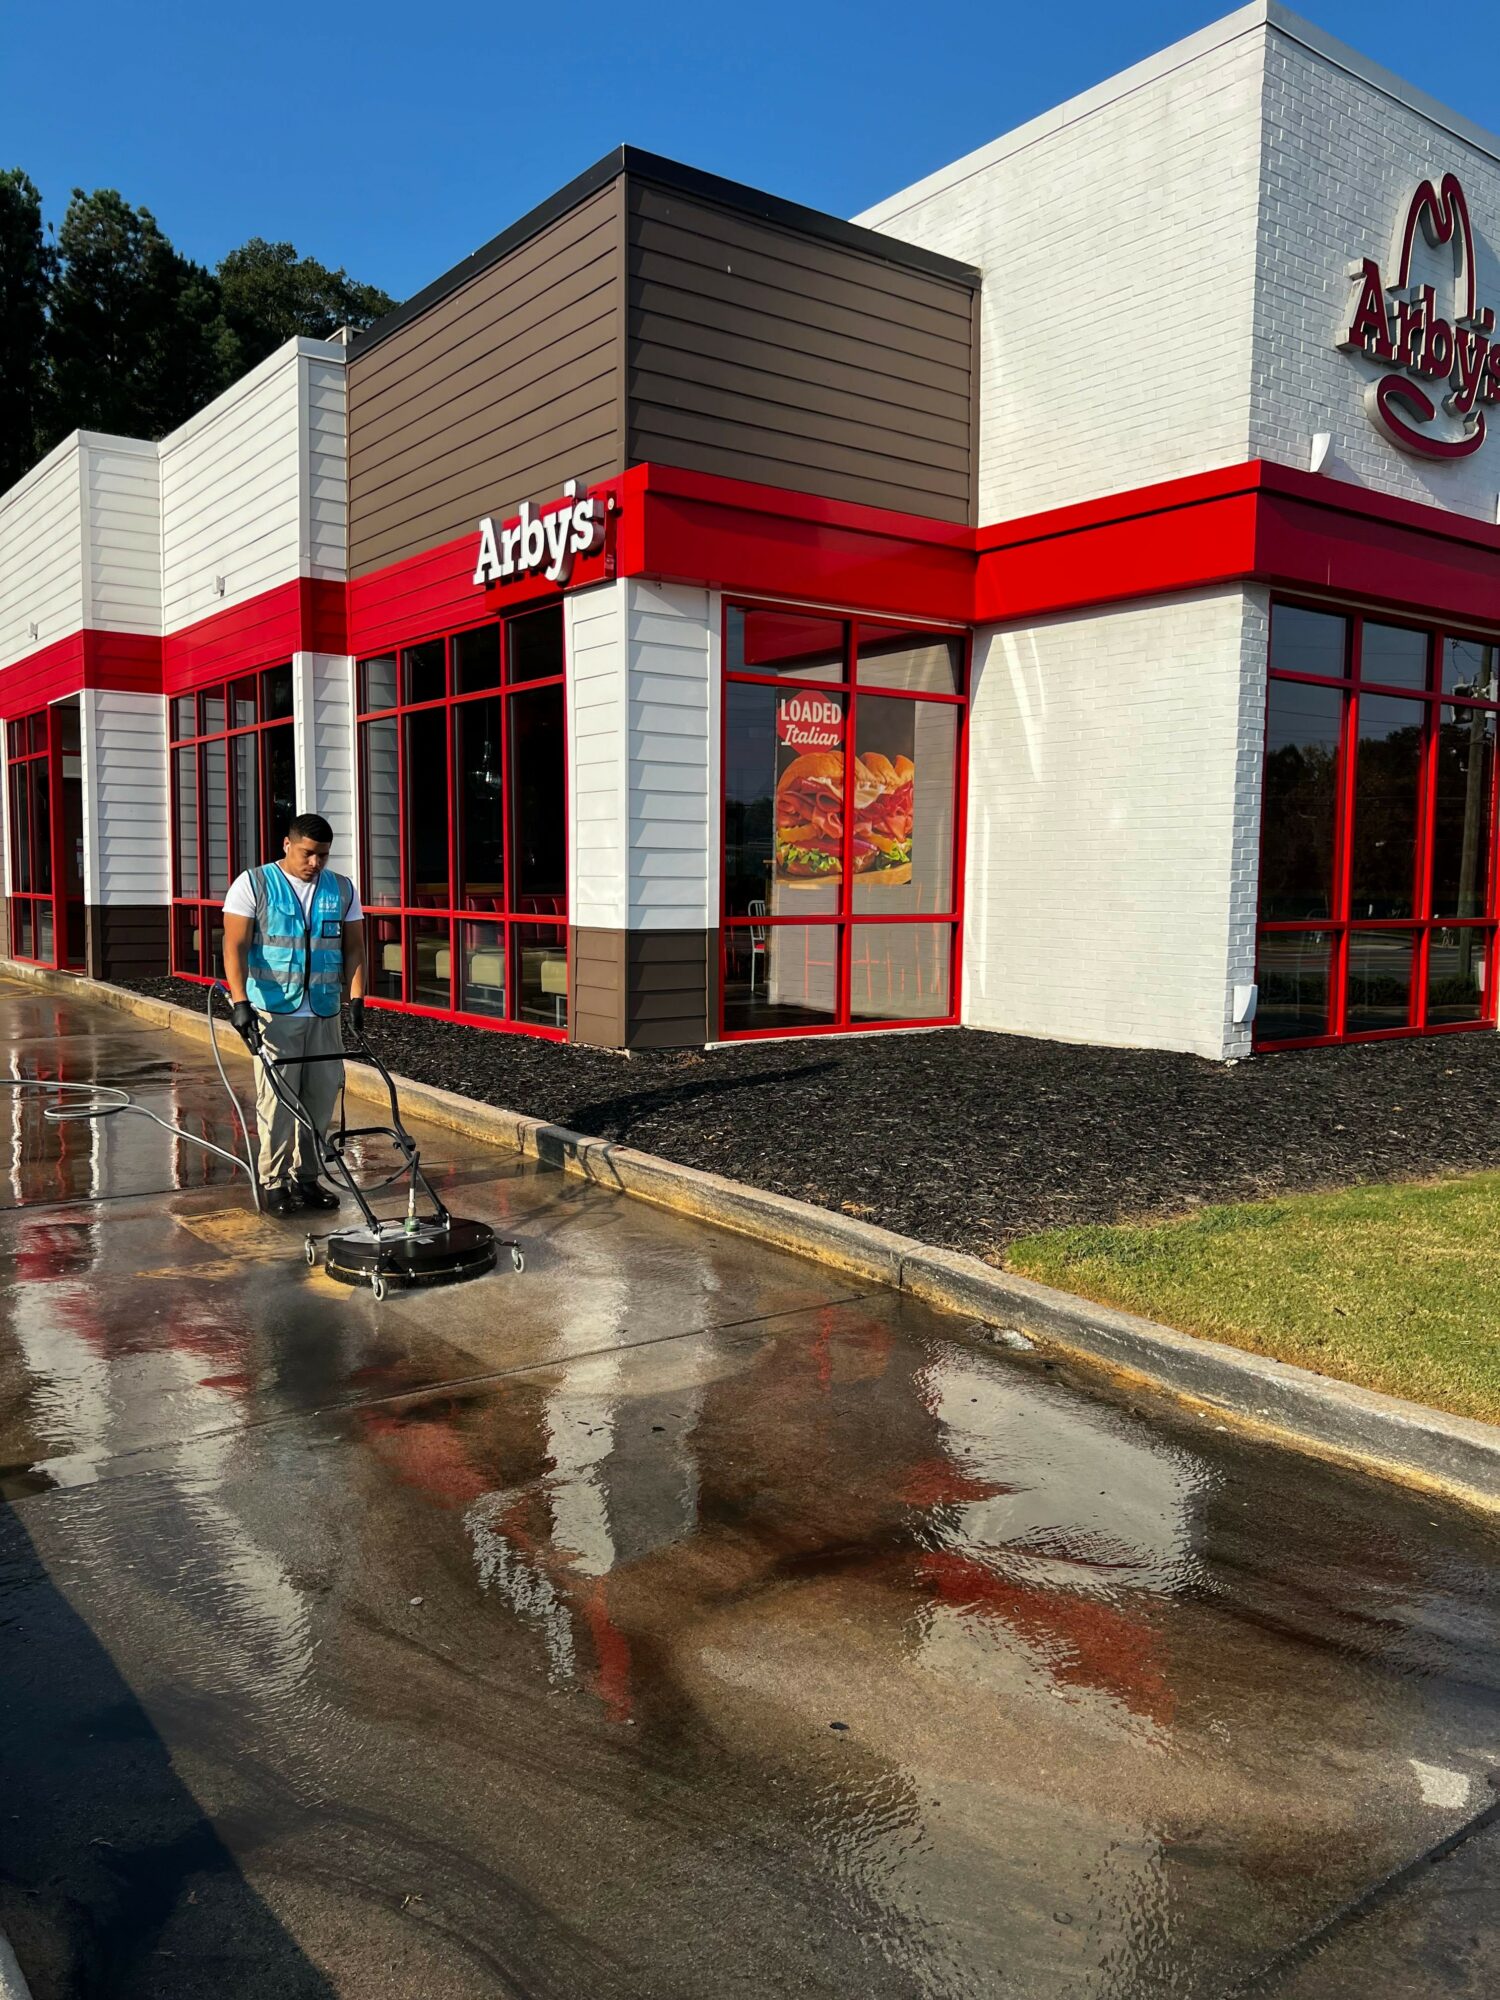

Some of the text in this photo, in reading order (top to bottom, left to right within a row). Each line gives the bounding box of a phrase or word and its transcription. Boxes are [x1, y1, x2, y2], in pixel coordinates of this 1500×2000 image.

[472, 479, 595, 585] Arby's
[780, 698, 842, 725] LOADED
[780, 724, 841, 746] Italian
